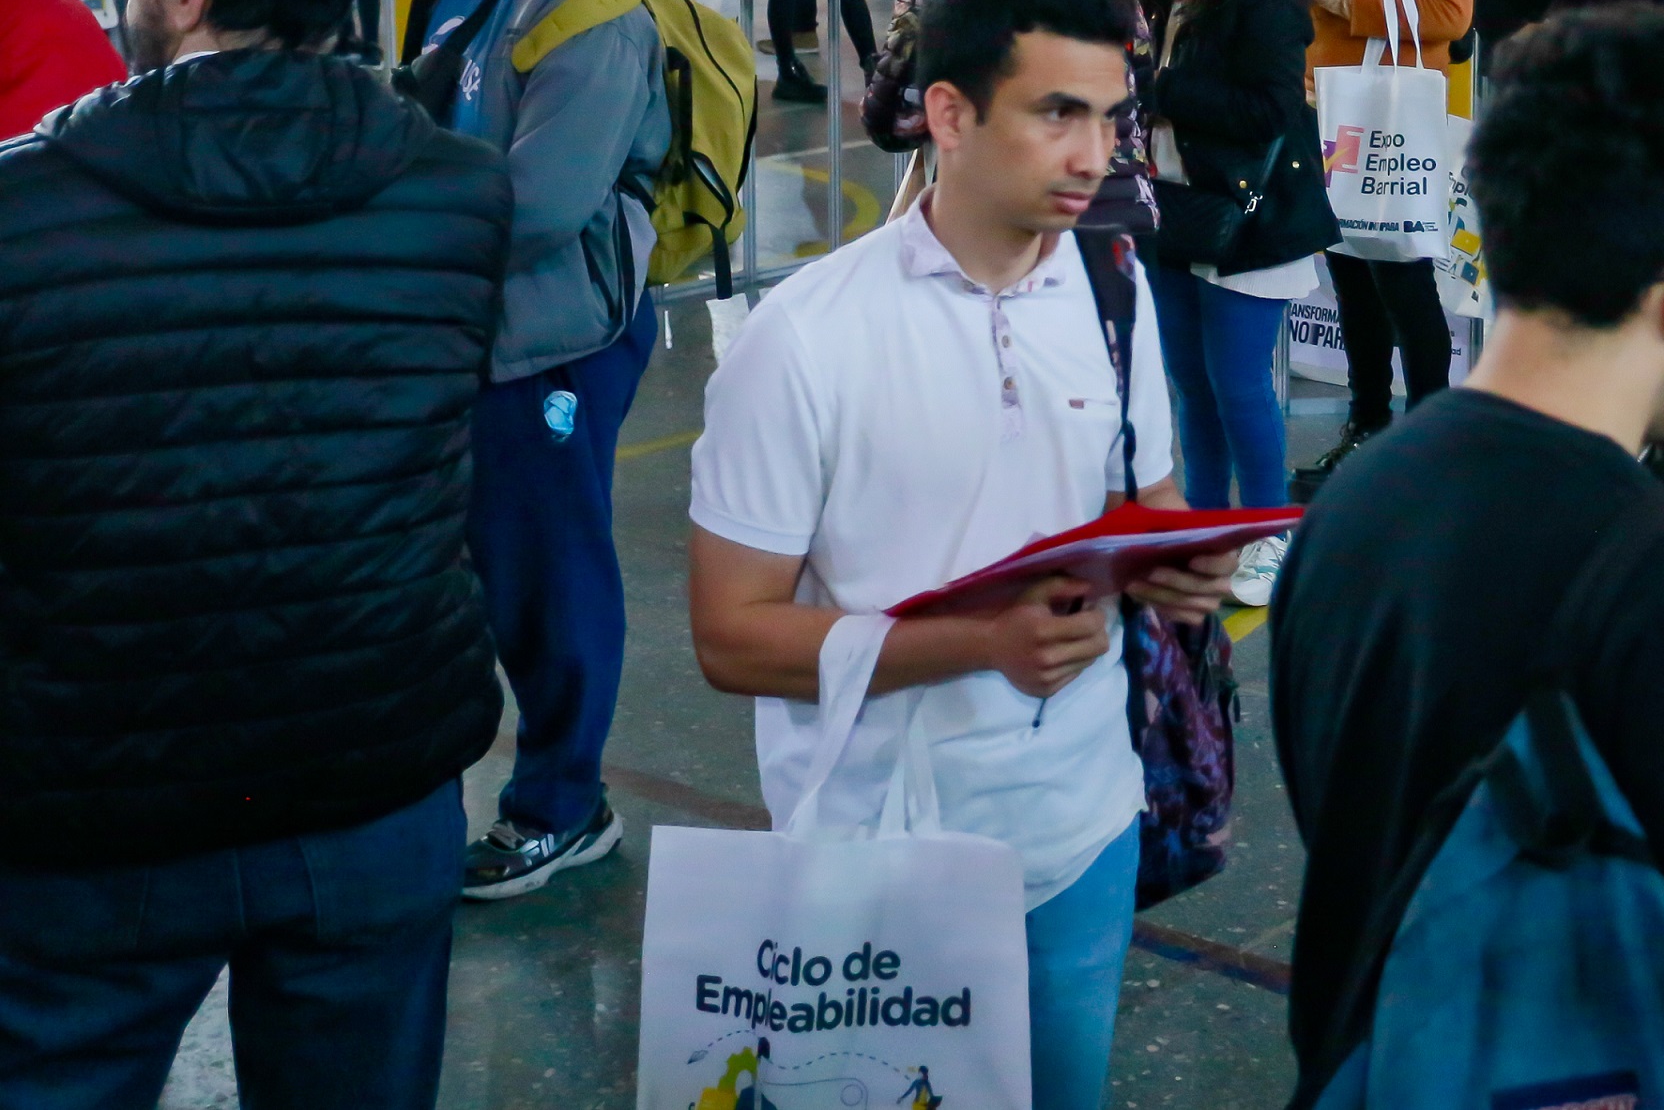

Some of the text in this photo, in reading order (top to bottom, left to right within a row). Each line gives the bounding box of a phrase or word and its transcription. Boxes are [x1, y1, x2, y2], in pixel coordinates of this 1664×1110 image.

[1369, 130, 1405, 150] Expo
[1365, 153, 1437, 176] Empleo
[1361, 176, 1428, 195] Barrial
[1403, 220, 1425, 233] BA
[1289, 302, 1339, 324] ANSFORM
[755, 938, 902, 987] Ciclo de
[695, 973, 972, 1034] Empleabilidad
